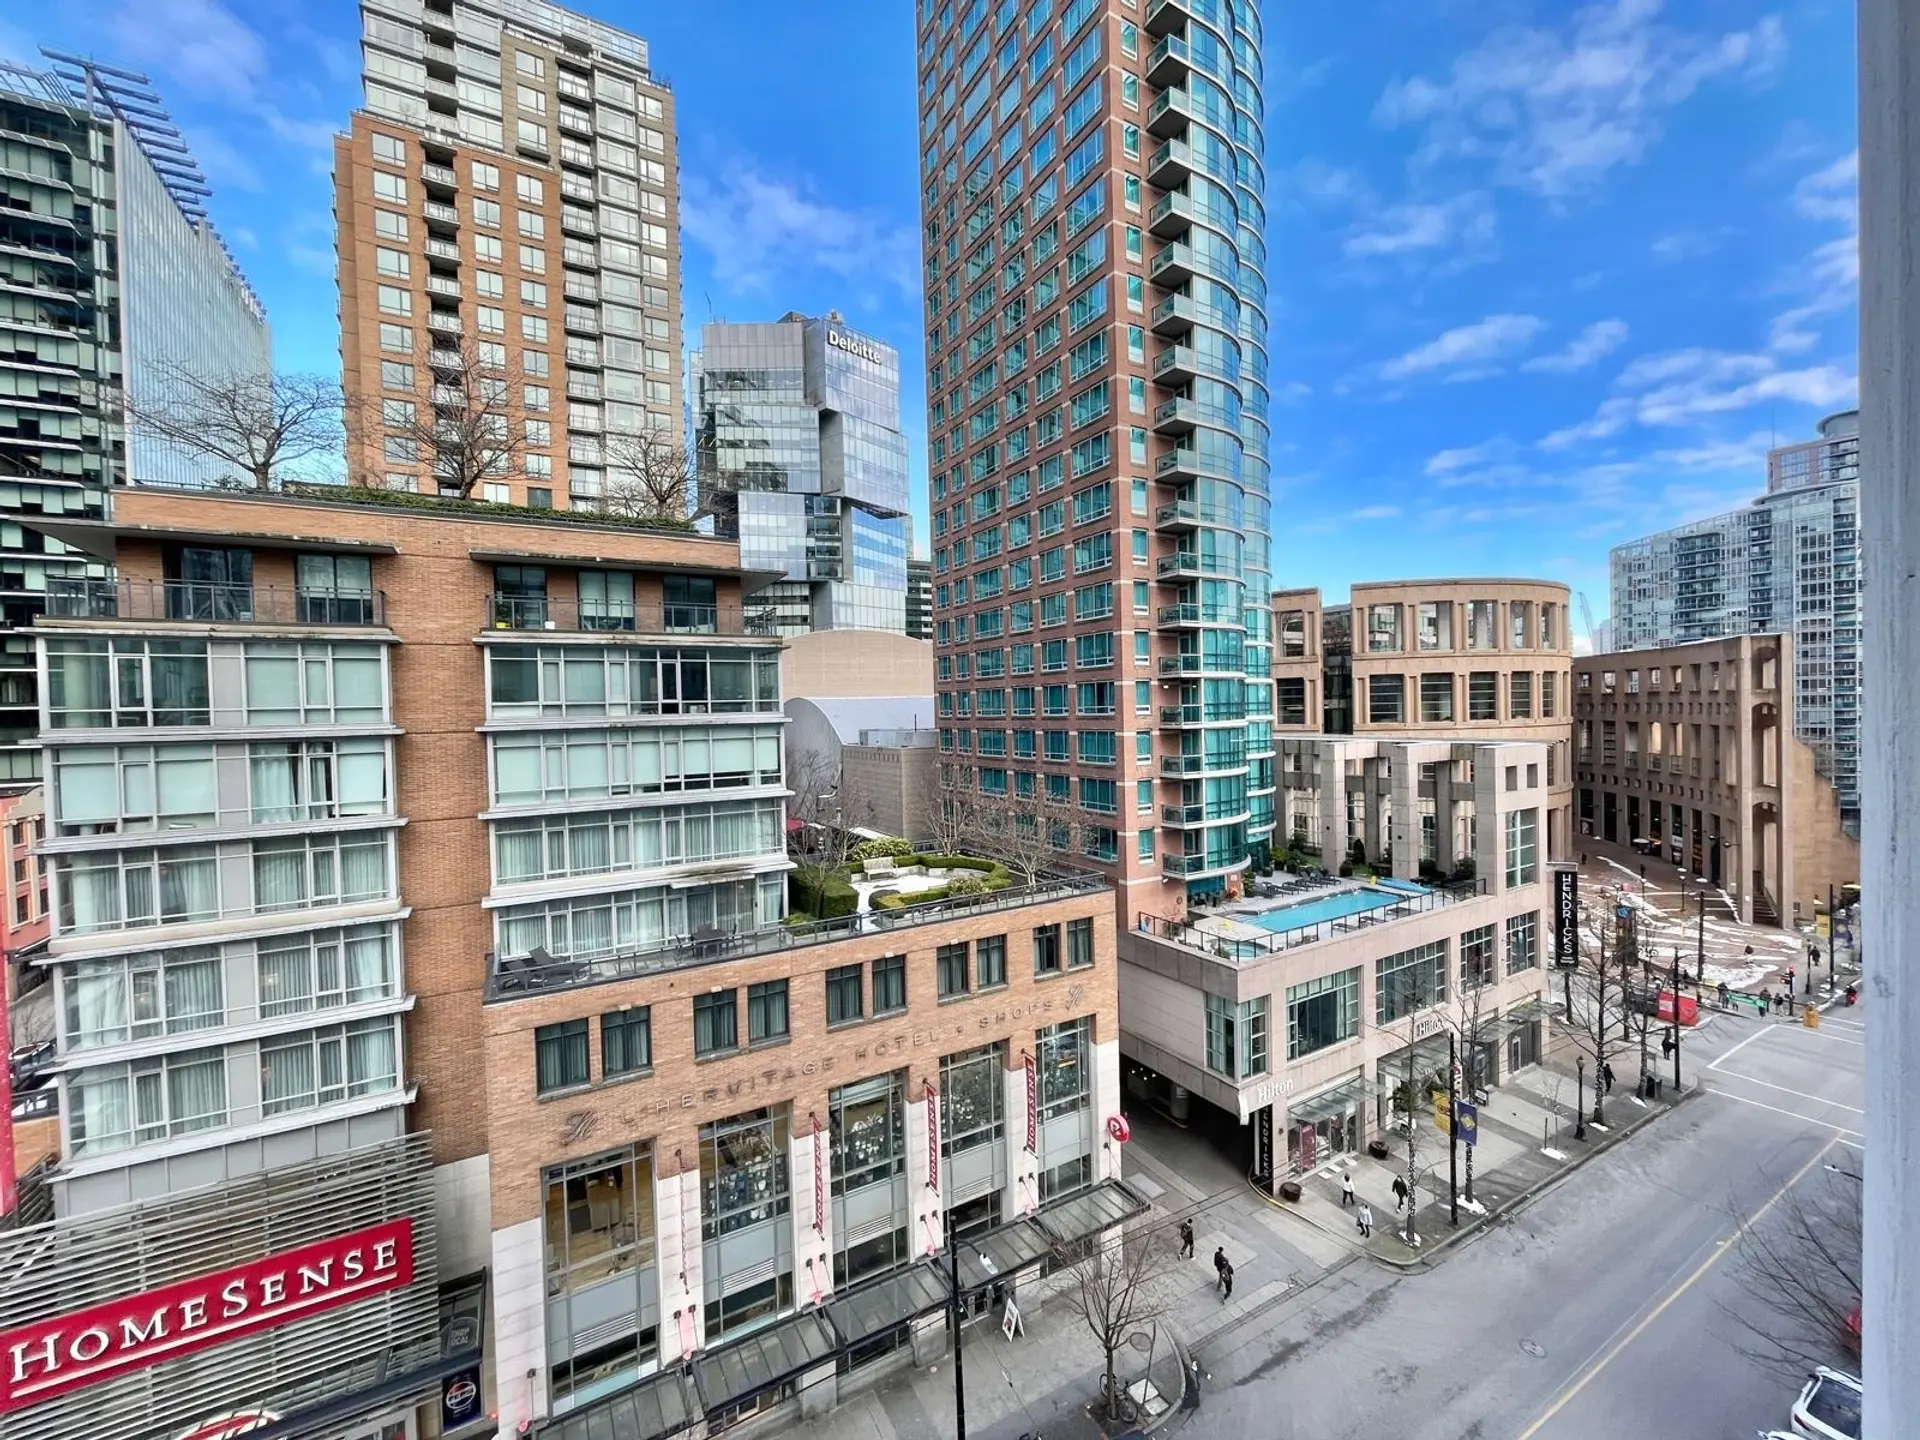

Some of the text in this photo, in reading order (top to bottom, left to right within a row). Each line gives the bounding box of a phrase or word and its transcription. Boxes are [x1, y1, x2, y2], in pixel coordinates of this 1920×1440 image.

[828, 330, 881, 364] Deloitte
[1562, 873, 1573, 954] HENDRICKS
[855, 1029, 940, 1062] HOTEL
[979, 999, 1052, 1028] SHOPS
[1027, 1063, 1037, 1151] HOMESENSE
[1257, 1078, 1294, 1102] Hilton
[927, 1095, 938, 1190] HOMESENSE
[10, 1238, 397, 1384] HOMESENSE
